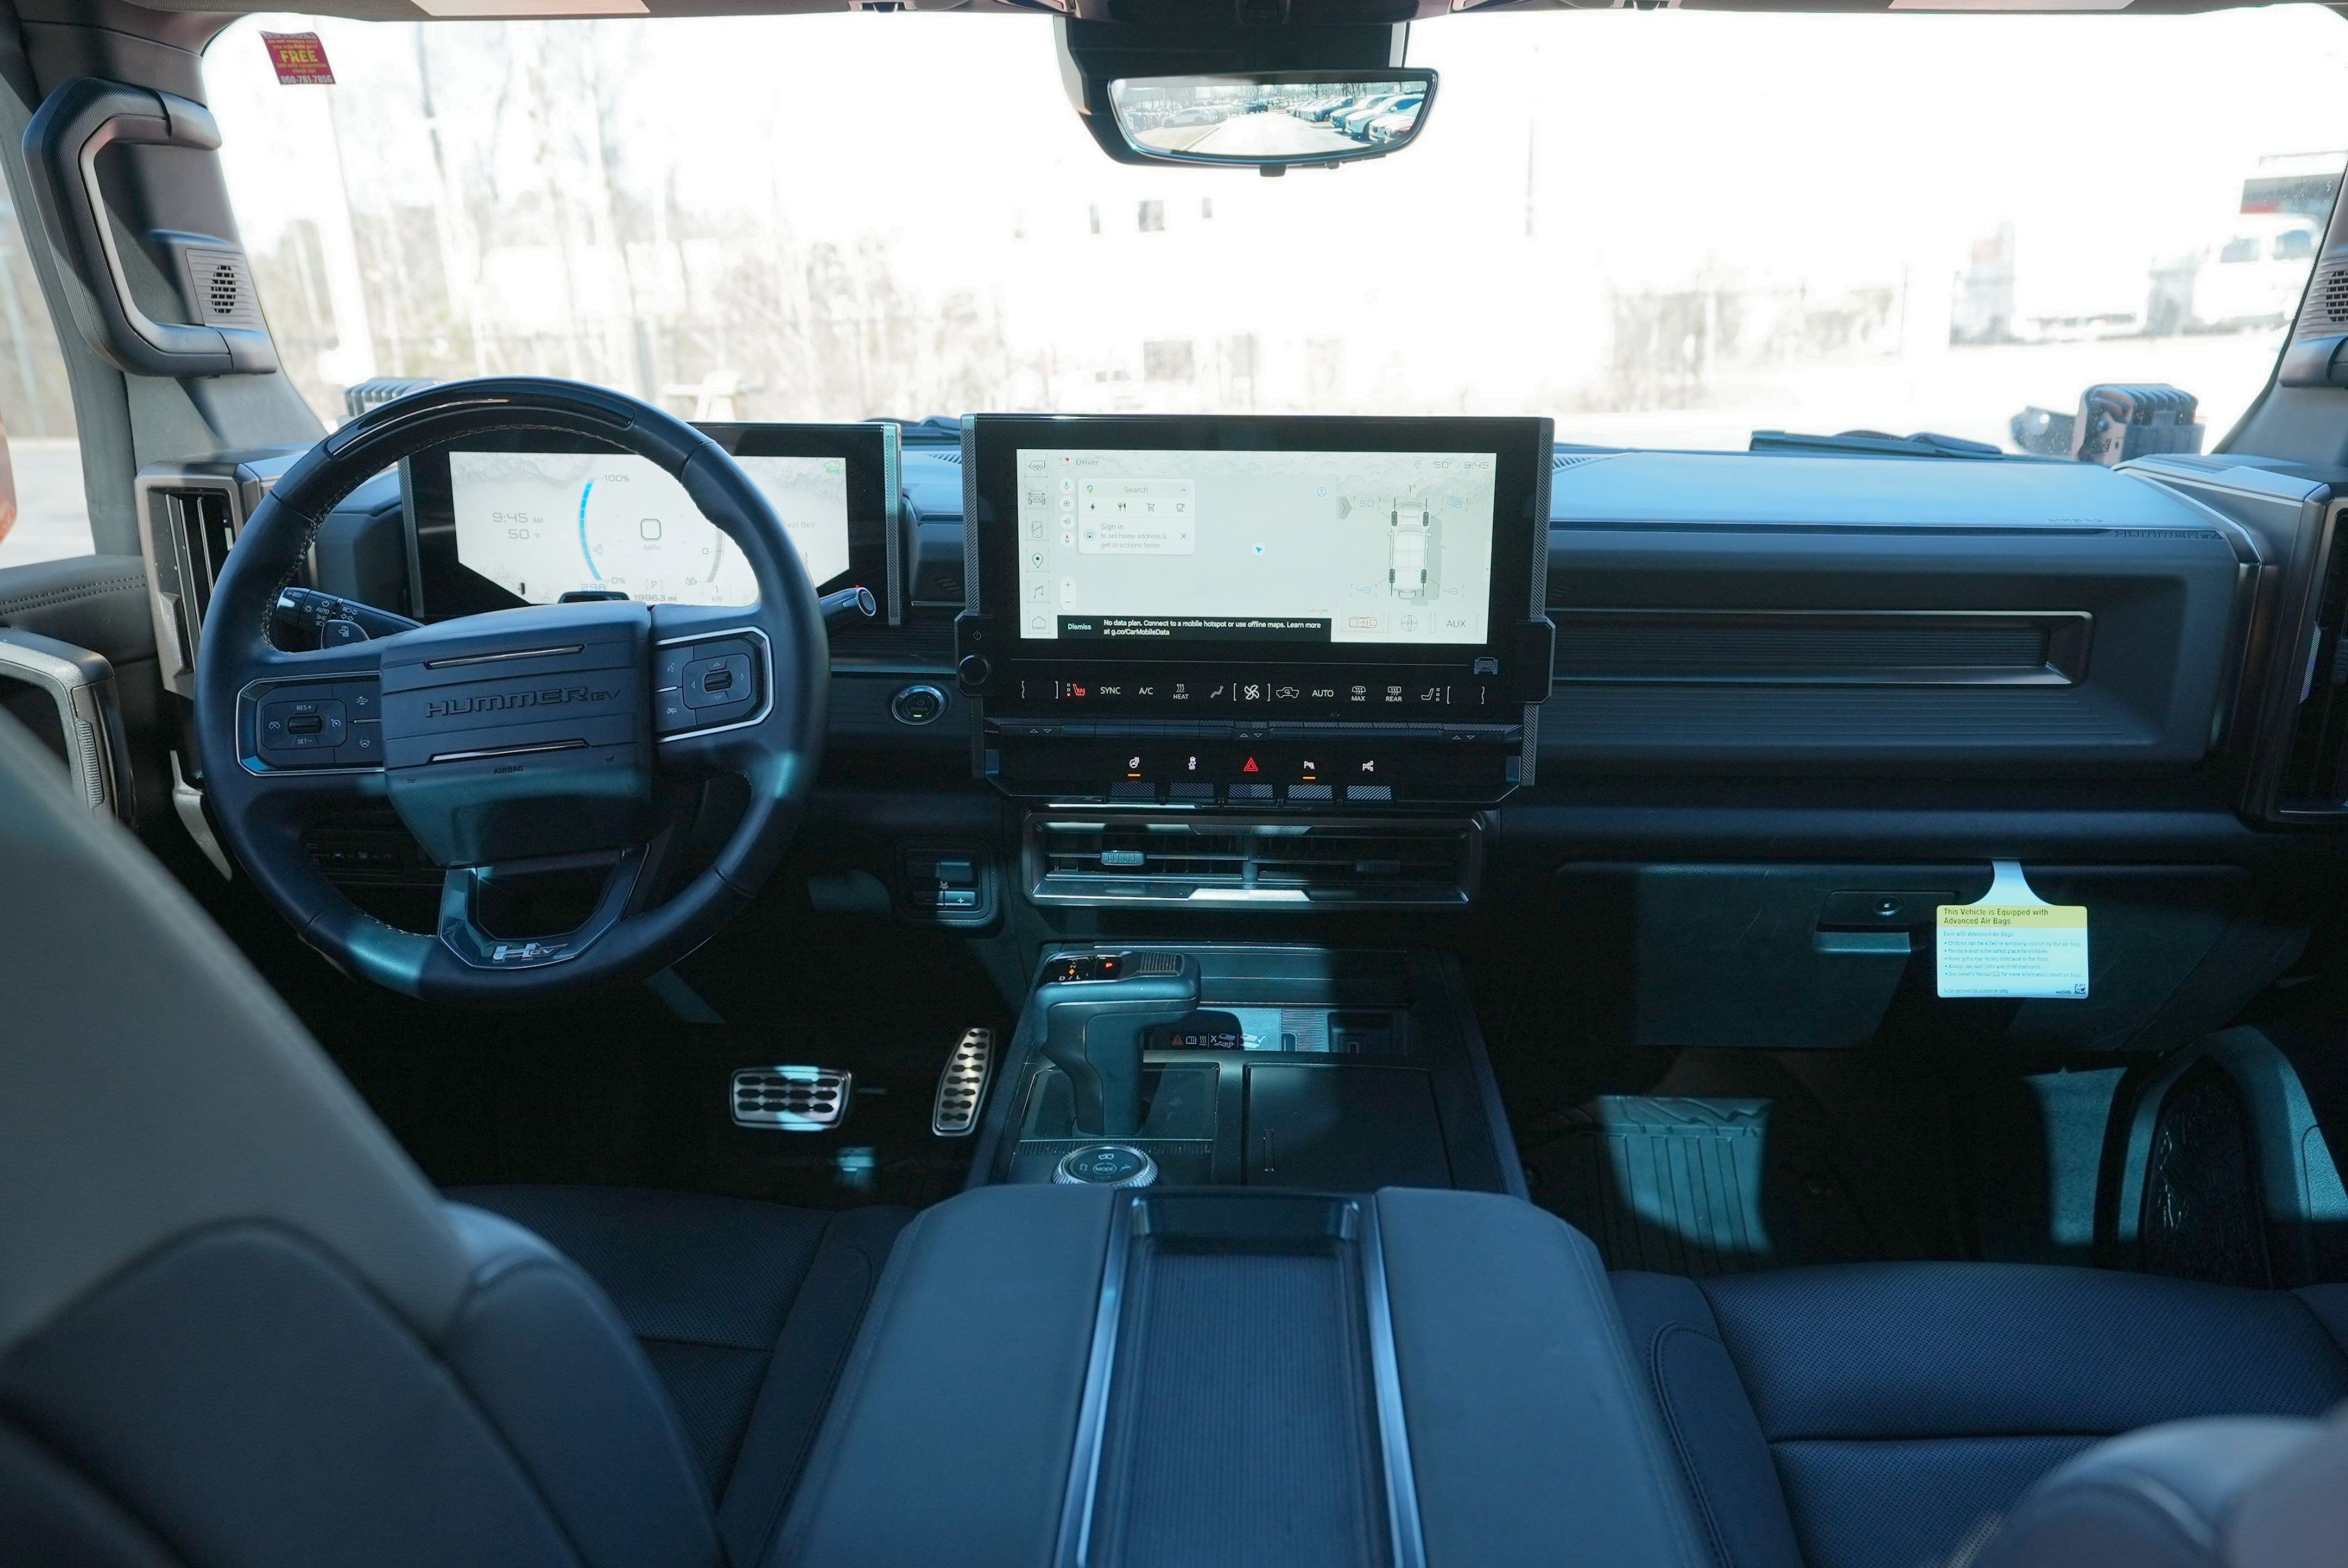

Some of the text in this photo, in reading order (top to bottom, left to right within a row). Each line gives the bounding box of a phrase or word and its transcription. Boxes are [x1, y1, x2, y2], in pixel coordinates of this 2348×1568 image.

[280, 50, 317, 63] FREE
[492, 512, 529, 523] 9:45
[640, 518, 661, 540] 0
[1100, 522, 1116, 531] Sign
[508, 529, 530, 539] 50
[581, 583, 606, 592] 298
[1128, 620, 1142, 628] plan.
[1203, 620, 1226, 629] hotspot
[1446, 620, 1466, 628] AUX
[426, 686, 622, 718] HUMMER EV
[493, 765, 524, 775] AIRBAG
[1997, 908, 2030, 917] Equipped
[1993, 917, 2012, 926] Bags
